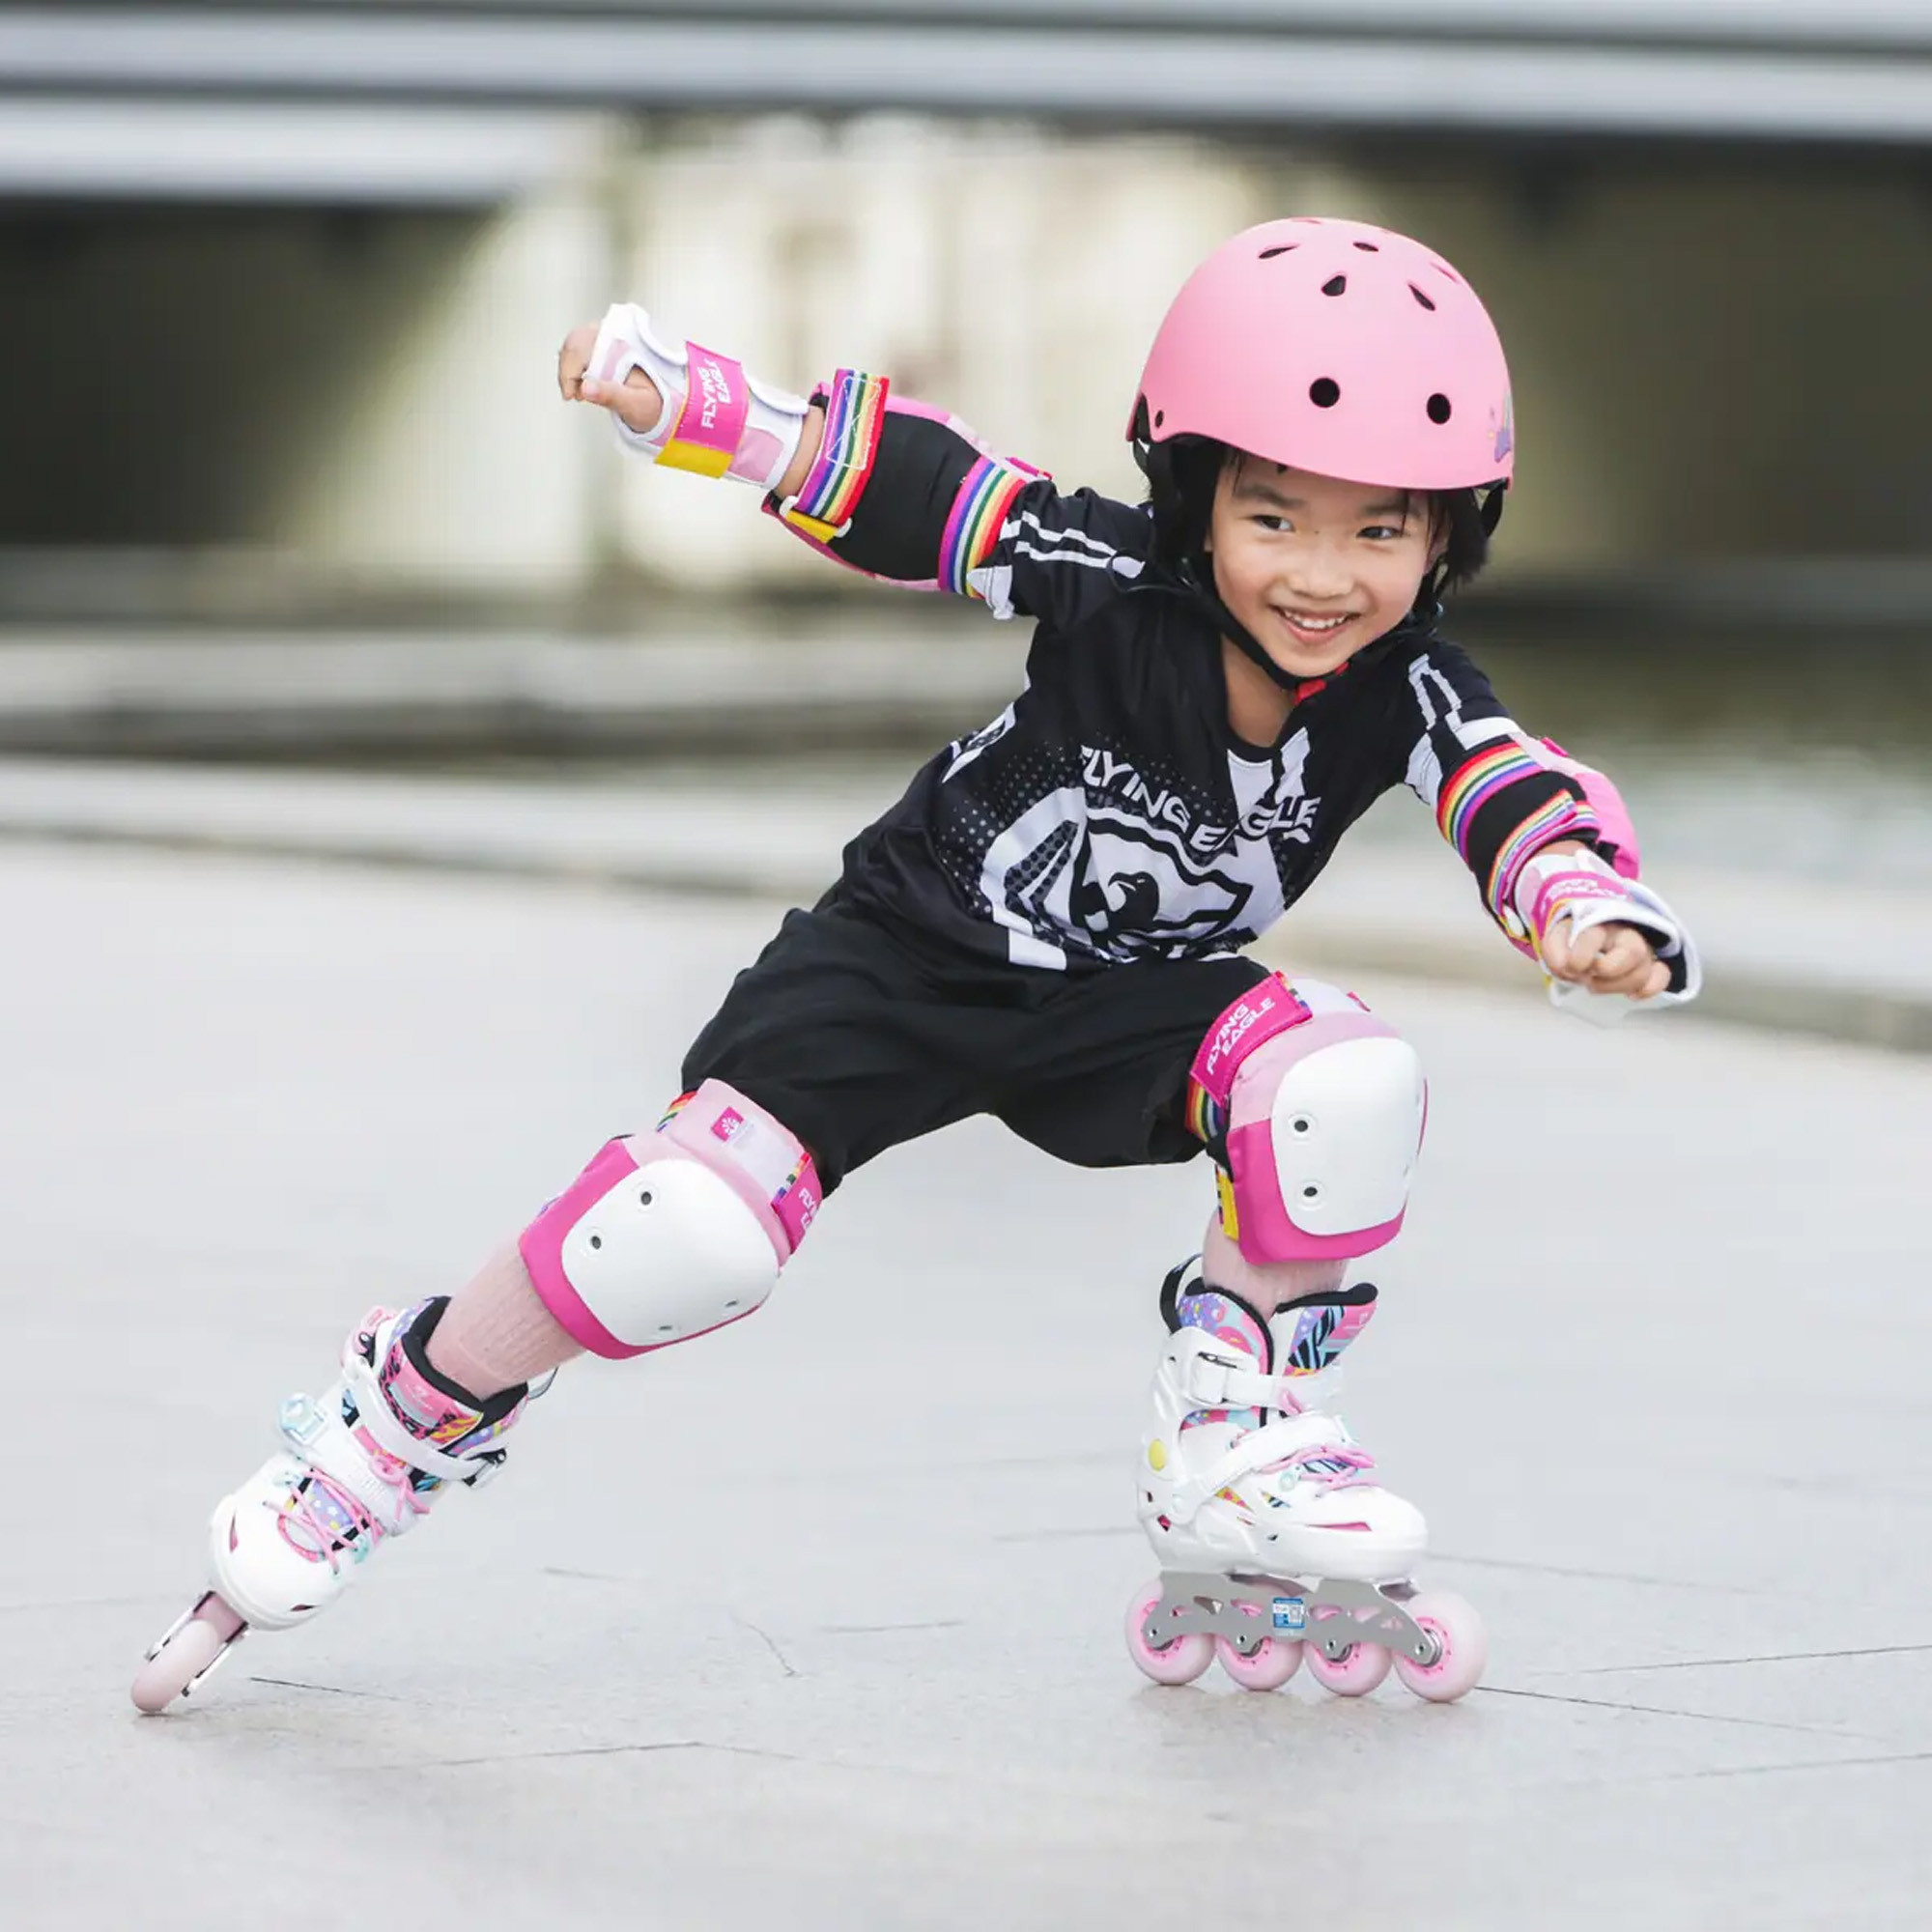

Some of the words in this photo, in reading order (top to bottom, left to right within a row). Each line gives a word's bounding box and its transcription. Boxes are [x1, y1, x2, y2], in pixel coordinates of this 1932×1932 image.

[696, 365, 717, 429] FLYING
[1189, 796, 1322, 852] EGLE
[1207, 1003, 1250, 1075] FLYING
[1220, 997, 1276, 1057] EAGLE
